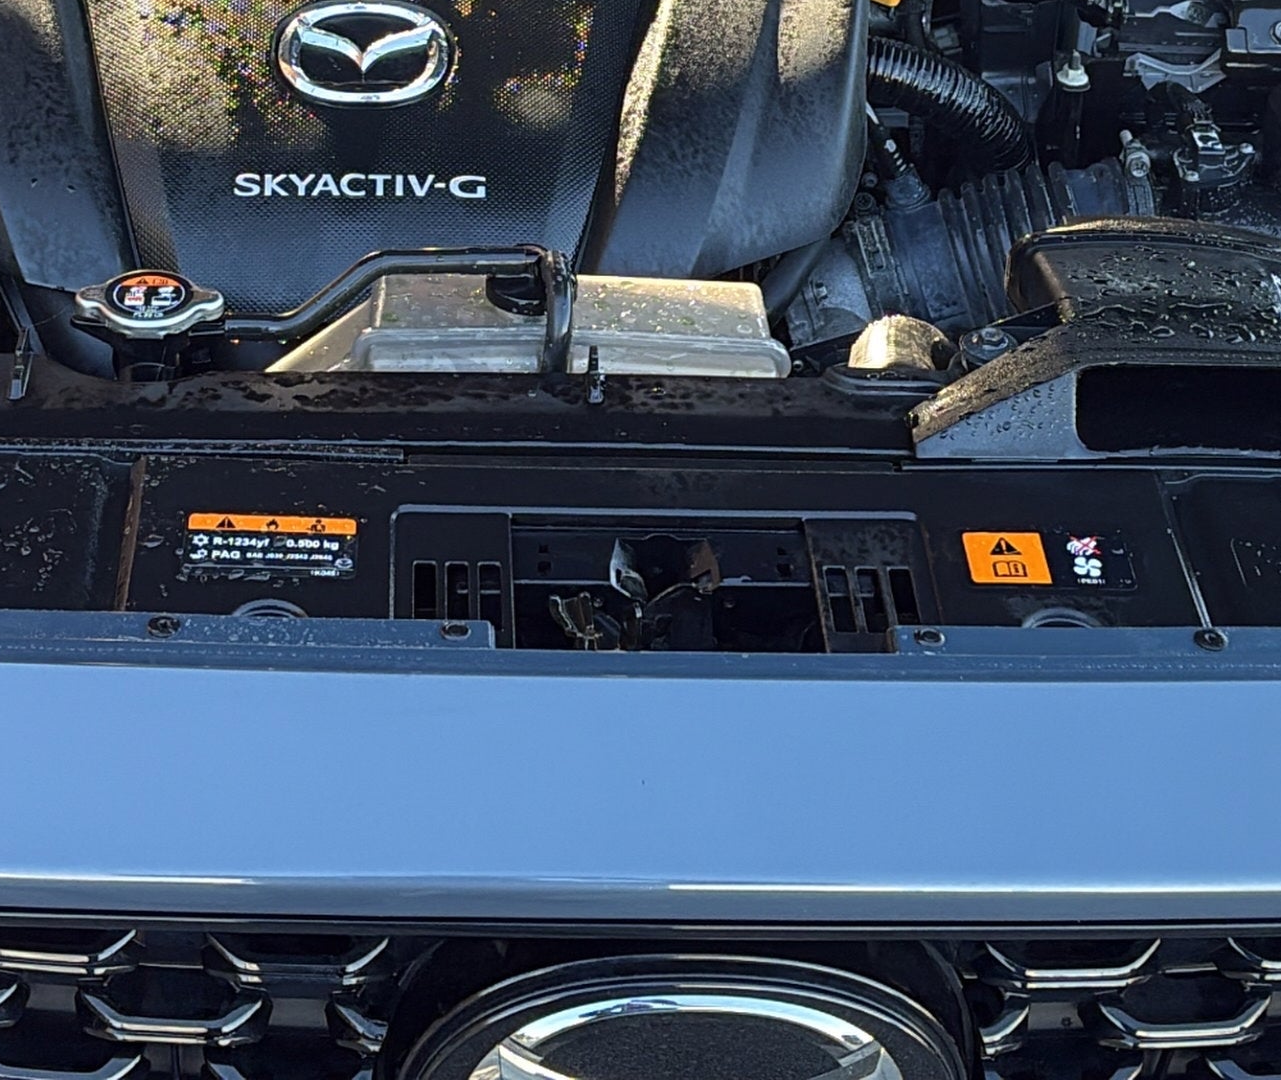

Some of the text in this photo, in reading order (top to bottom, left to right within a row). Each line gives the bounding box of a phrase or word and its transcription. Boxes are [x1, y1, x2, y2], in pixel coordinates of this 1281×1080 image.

[233, 172, 487, 198] SKYACTIV-G
[213, 537, 269, 548] R-1234yf
[322, 539, 340, 551] kg
[211, 550, 240, 559] PAG
